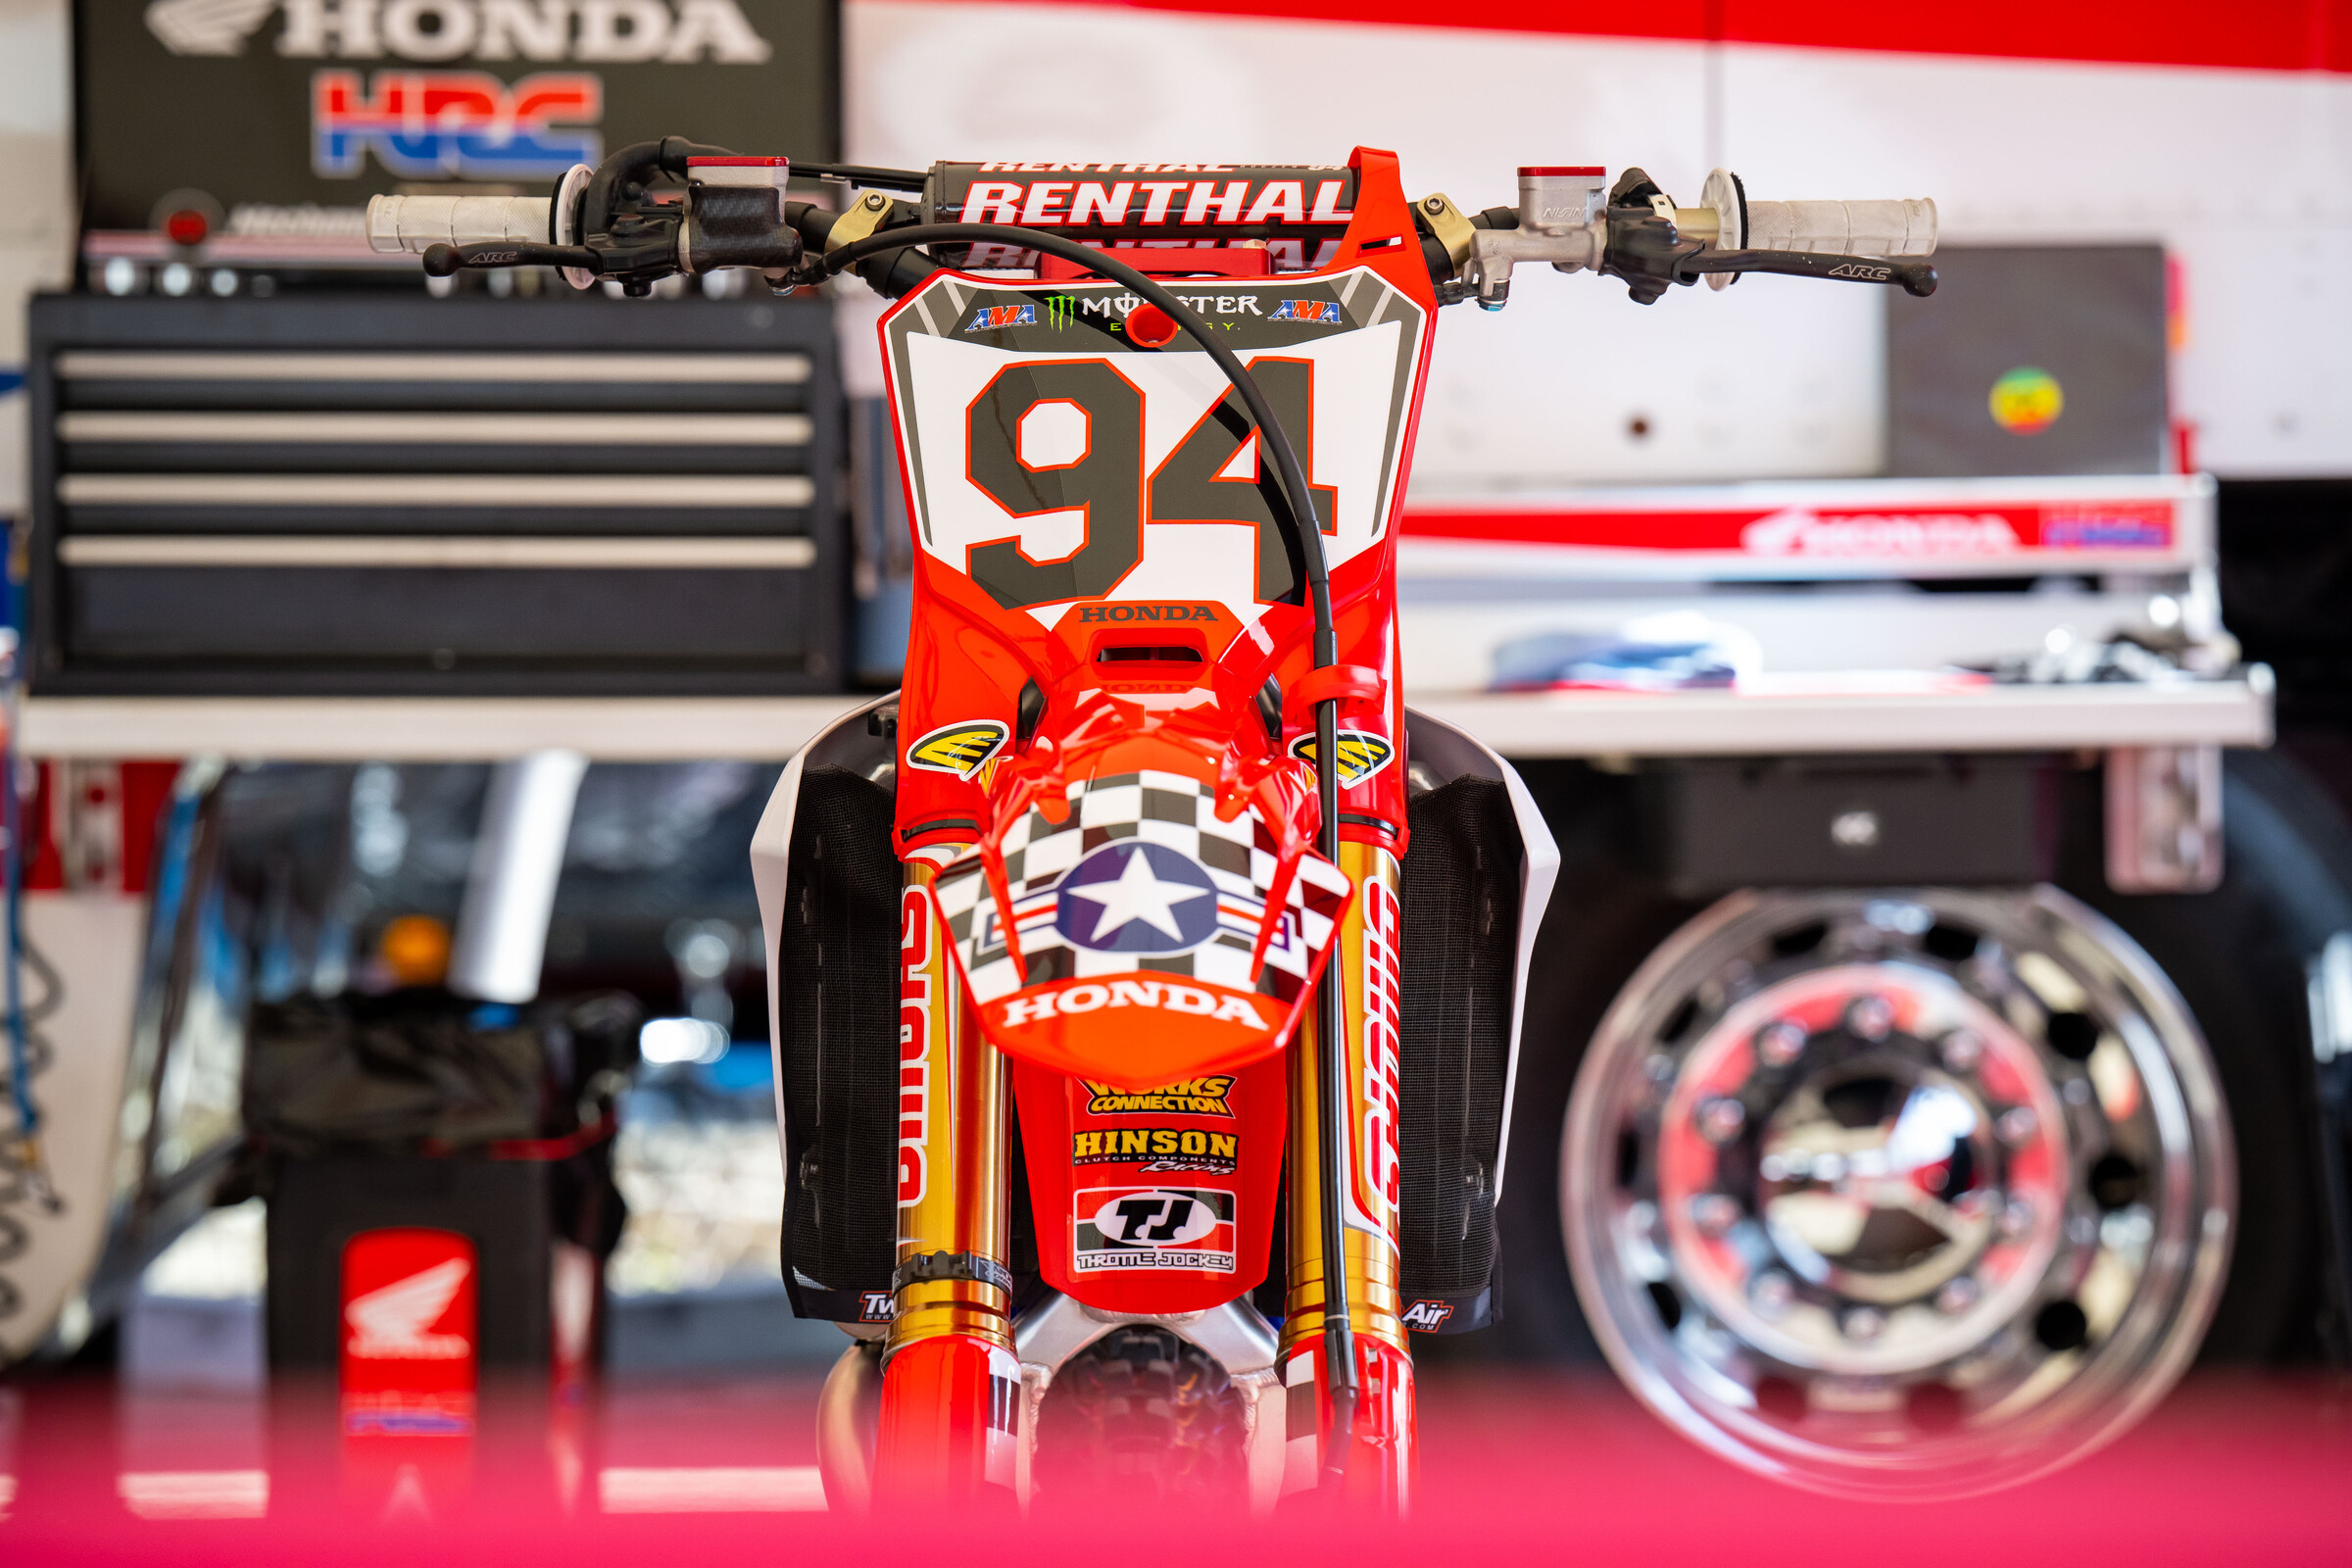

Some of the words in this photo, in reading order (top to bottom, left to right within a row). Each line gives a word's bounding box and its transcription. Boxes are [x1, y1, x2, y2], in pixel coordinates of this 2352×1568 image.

[278, 0, 772, 62] HONDA
[312, 71, 600, 178] HRC
[958, 180, 1355, 226] RENTHAL
[468, 251, 517, 264] ARC
[1829, 264, 1891, 280] ARC
[1082, 292, 1262, 318] MOTER
[1267, 299, 1343, 324] AMA
[964, 304, 1038, 332] AMA
[965, 356, 1338, 611] 94
[1079, 606, 1218, 622] HONDA
[1003, 980, 1270, 1031] HONDA
[1084, 1077, 1231, 1098] WRKS
[1090, 1096, 1229, 1114] CONNECTION
[1074, 1130, 1237, 1158] HINSON
[1074, 1155, 1131, 1164] CLUTCH
[1138, 1155, 1236, 1165] COMPONENTS
[1115, 1200, 1195, 1241] TJ
[1077, 1252, 1156, 1269] THROTTLE
[1157, 1252, 1234, 1271] JOCKEY
[1401, 1302, 1448, 1325] Air
